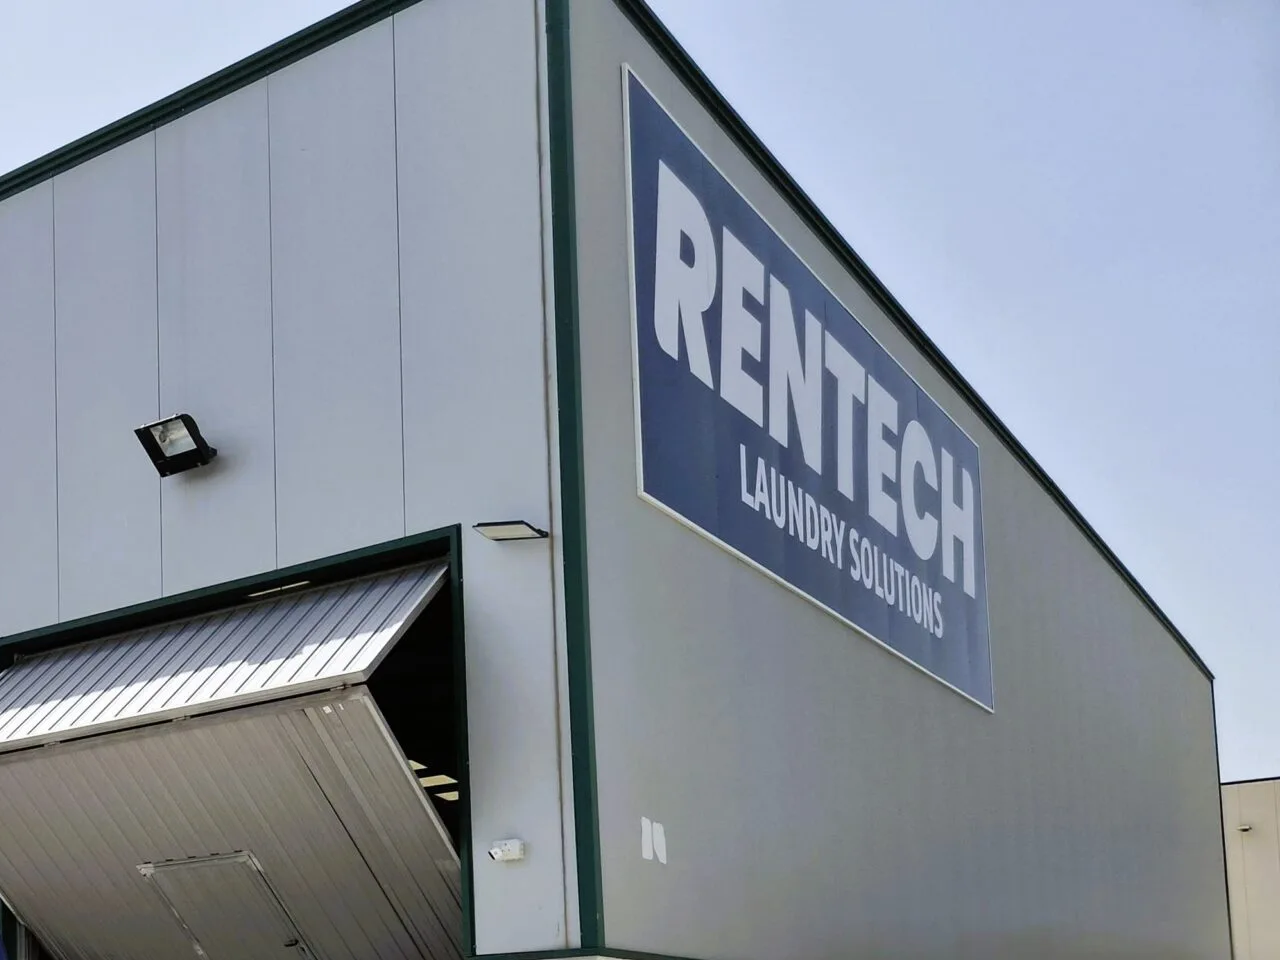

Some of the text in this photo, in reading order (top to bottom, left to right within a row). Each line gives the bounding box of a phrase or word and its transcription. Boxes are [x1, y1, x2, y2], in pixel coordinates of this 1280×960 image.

[653, 159, 975, 599] RENTECH
[739, 443, 944, 639] LAUNDRY SOLUTIONS
